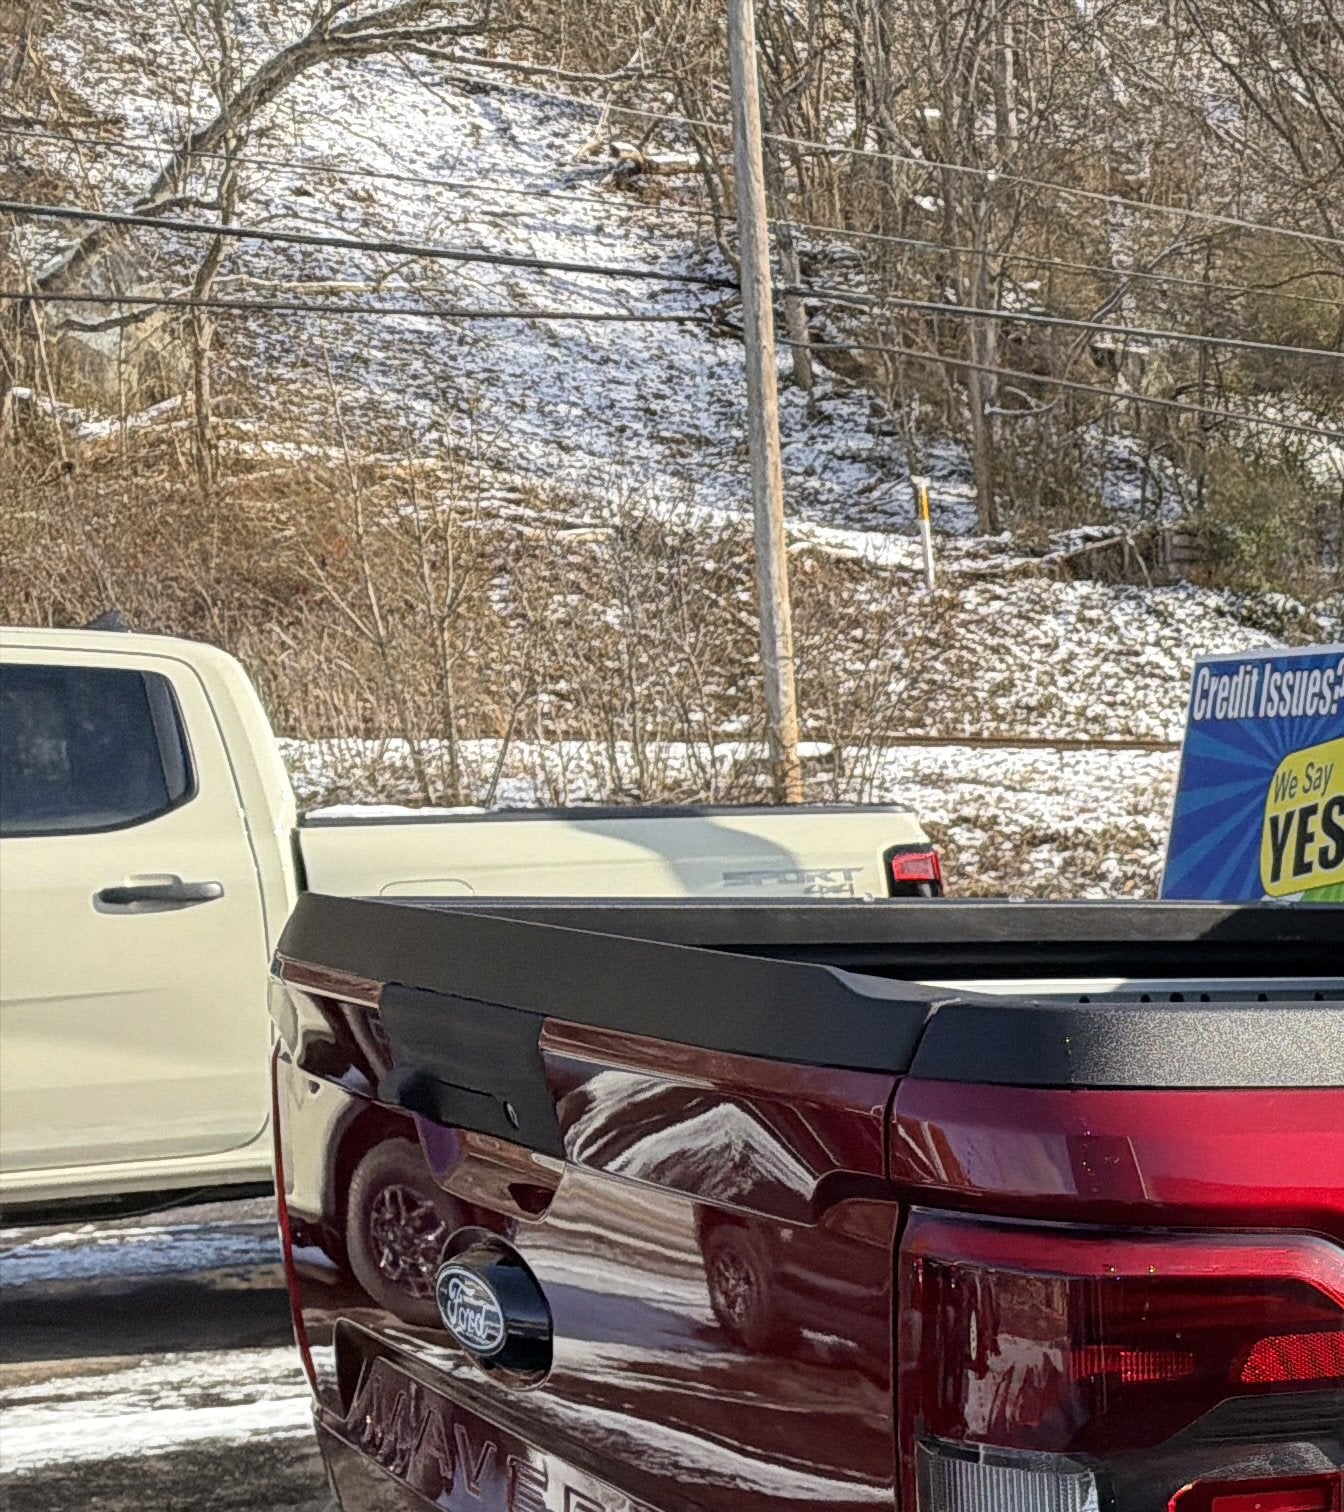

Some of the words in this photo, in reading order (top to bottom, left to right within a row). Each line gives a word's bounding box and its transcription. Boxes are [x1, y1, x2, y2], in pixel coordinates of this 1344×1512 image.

[1193, 665, 1259, 721] Credit
[1273, 769, 1298, 804] We
[1302, 761, 1334, 797] Say
[447, 1277, 489, 1340] Ford
